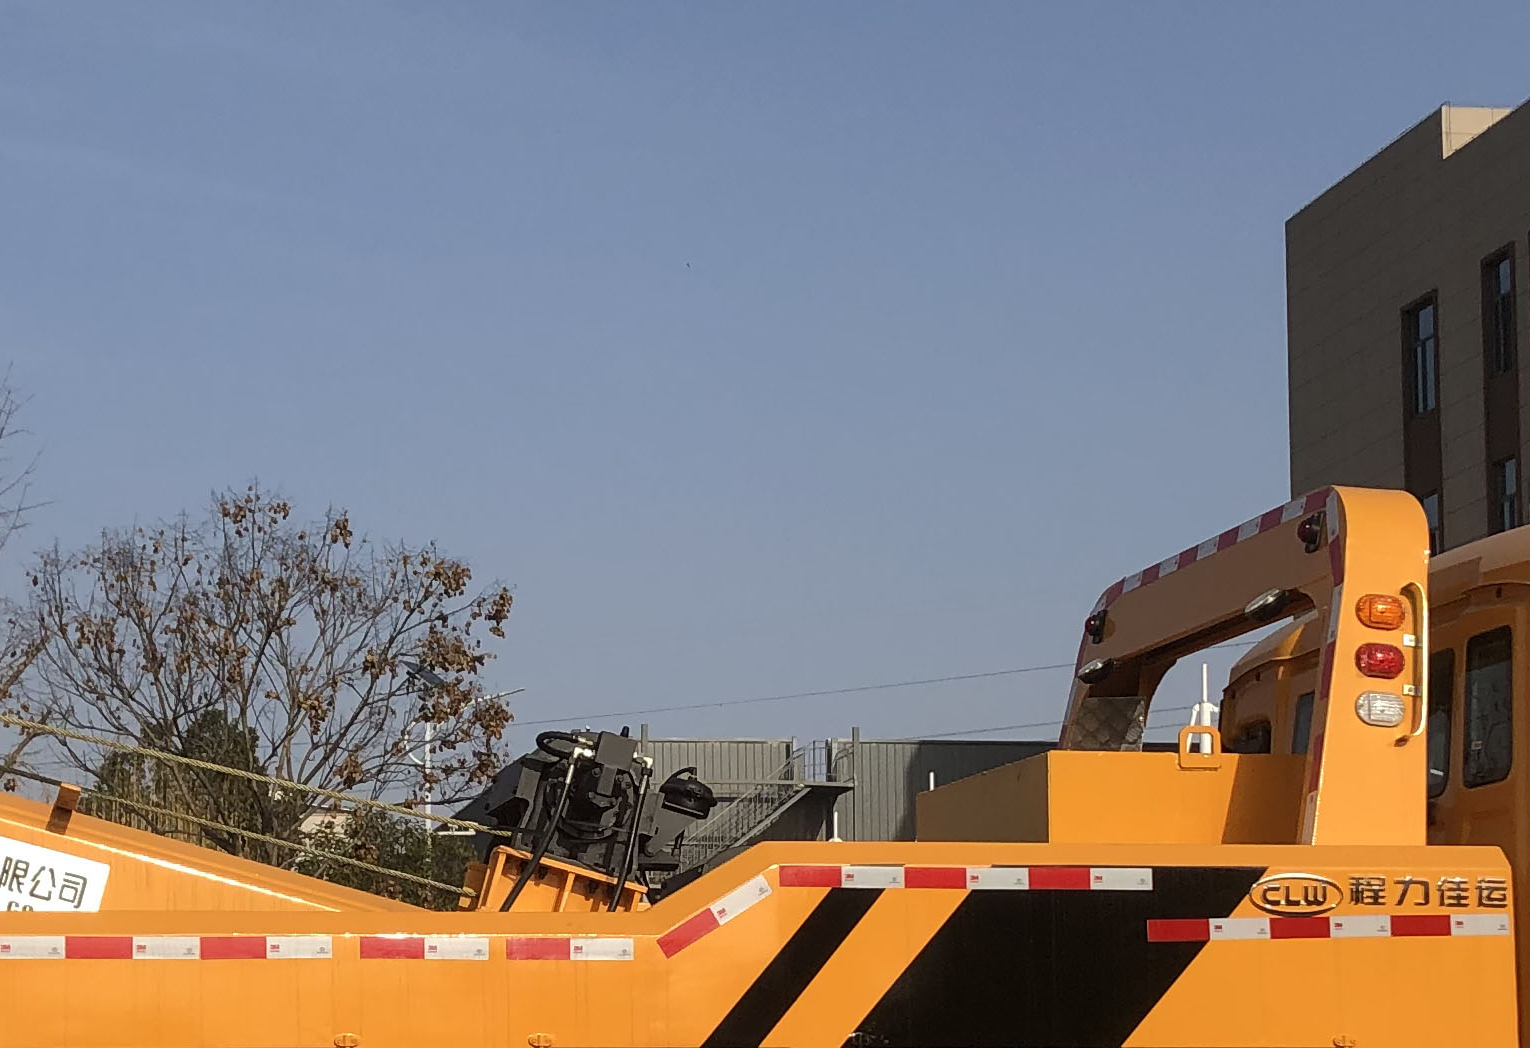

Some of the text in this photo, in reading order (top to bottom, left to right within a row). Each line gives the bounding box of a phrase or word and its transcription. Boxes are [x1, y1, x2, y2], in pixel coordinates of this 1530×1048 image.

[1262, 884, 1328, 907] CLW
[1348, 875, 1508, 908] 程力佳运
